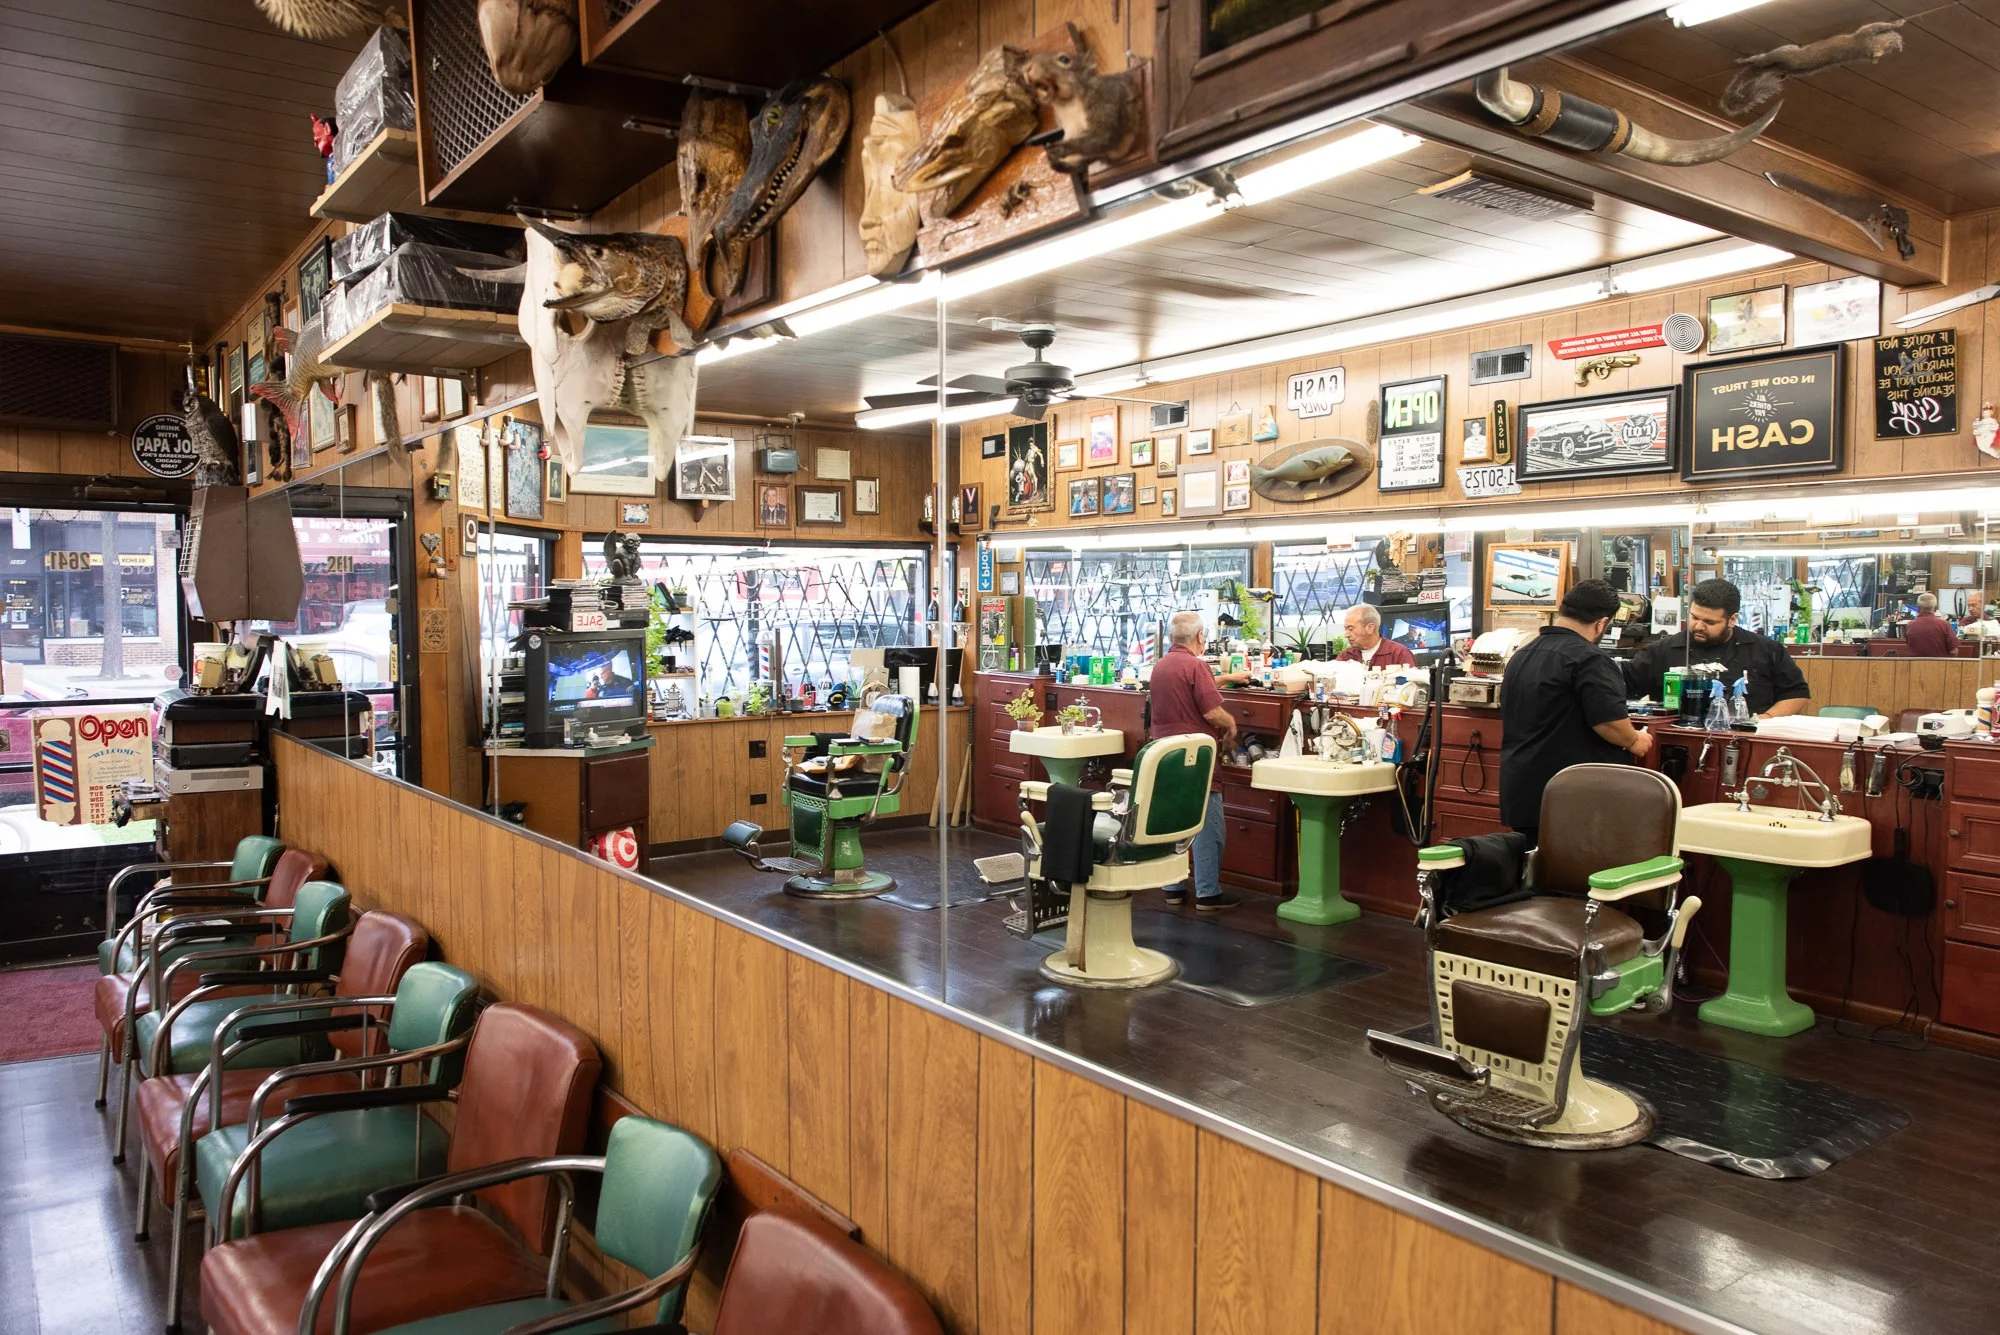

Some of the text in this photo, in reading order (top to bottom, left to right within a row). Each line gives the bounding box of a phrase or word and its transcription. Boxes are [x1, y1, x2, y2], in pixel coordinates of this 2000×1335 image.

[136, 437, 170, 453] PAPA
[143, 460, 182, 475] ESTABLISHED
[1420, 592, 1440, 600] SALE
[78, 714, 149, 747] Open
[92, 747, 136, 758] WELCOME
